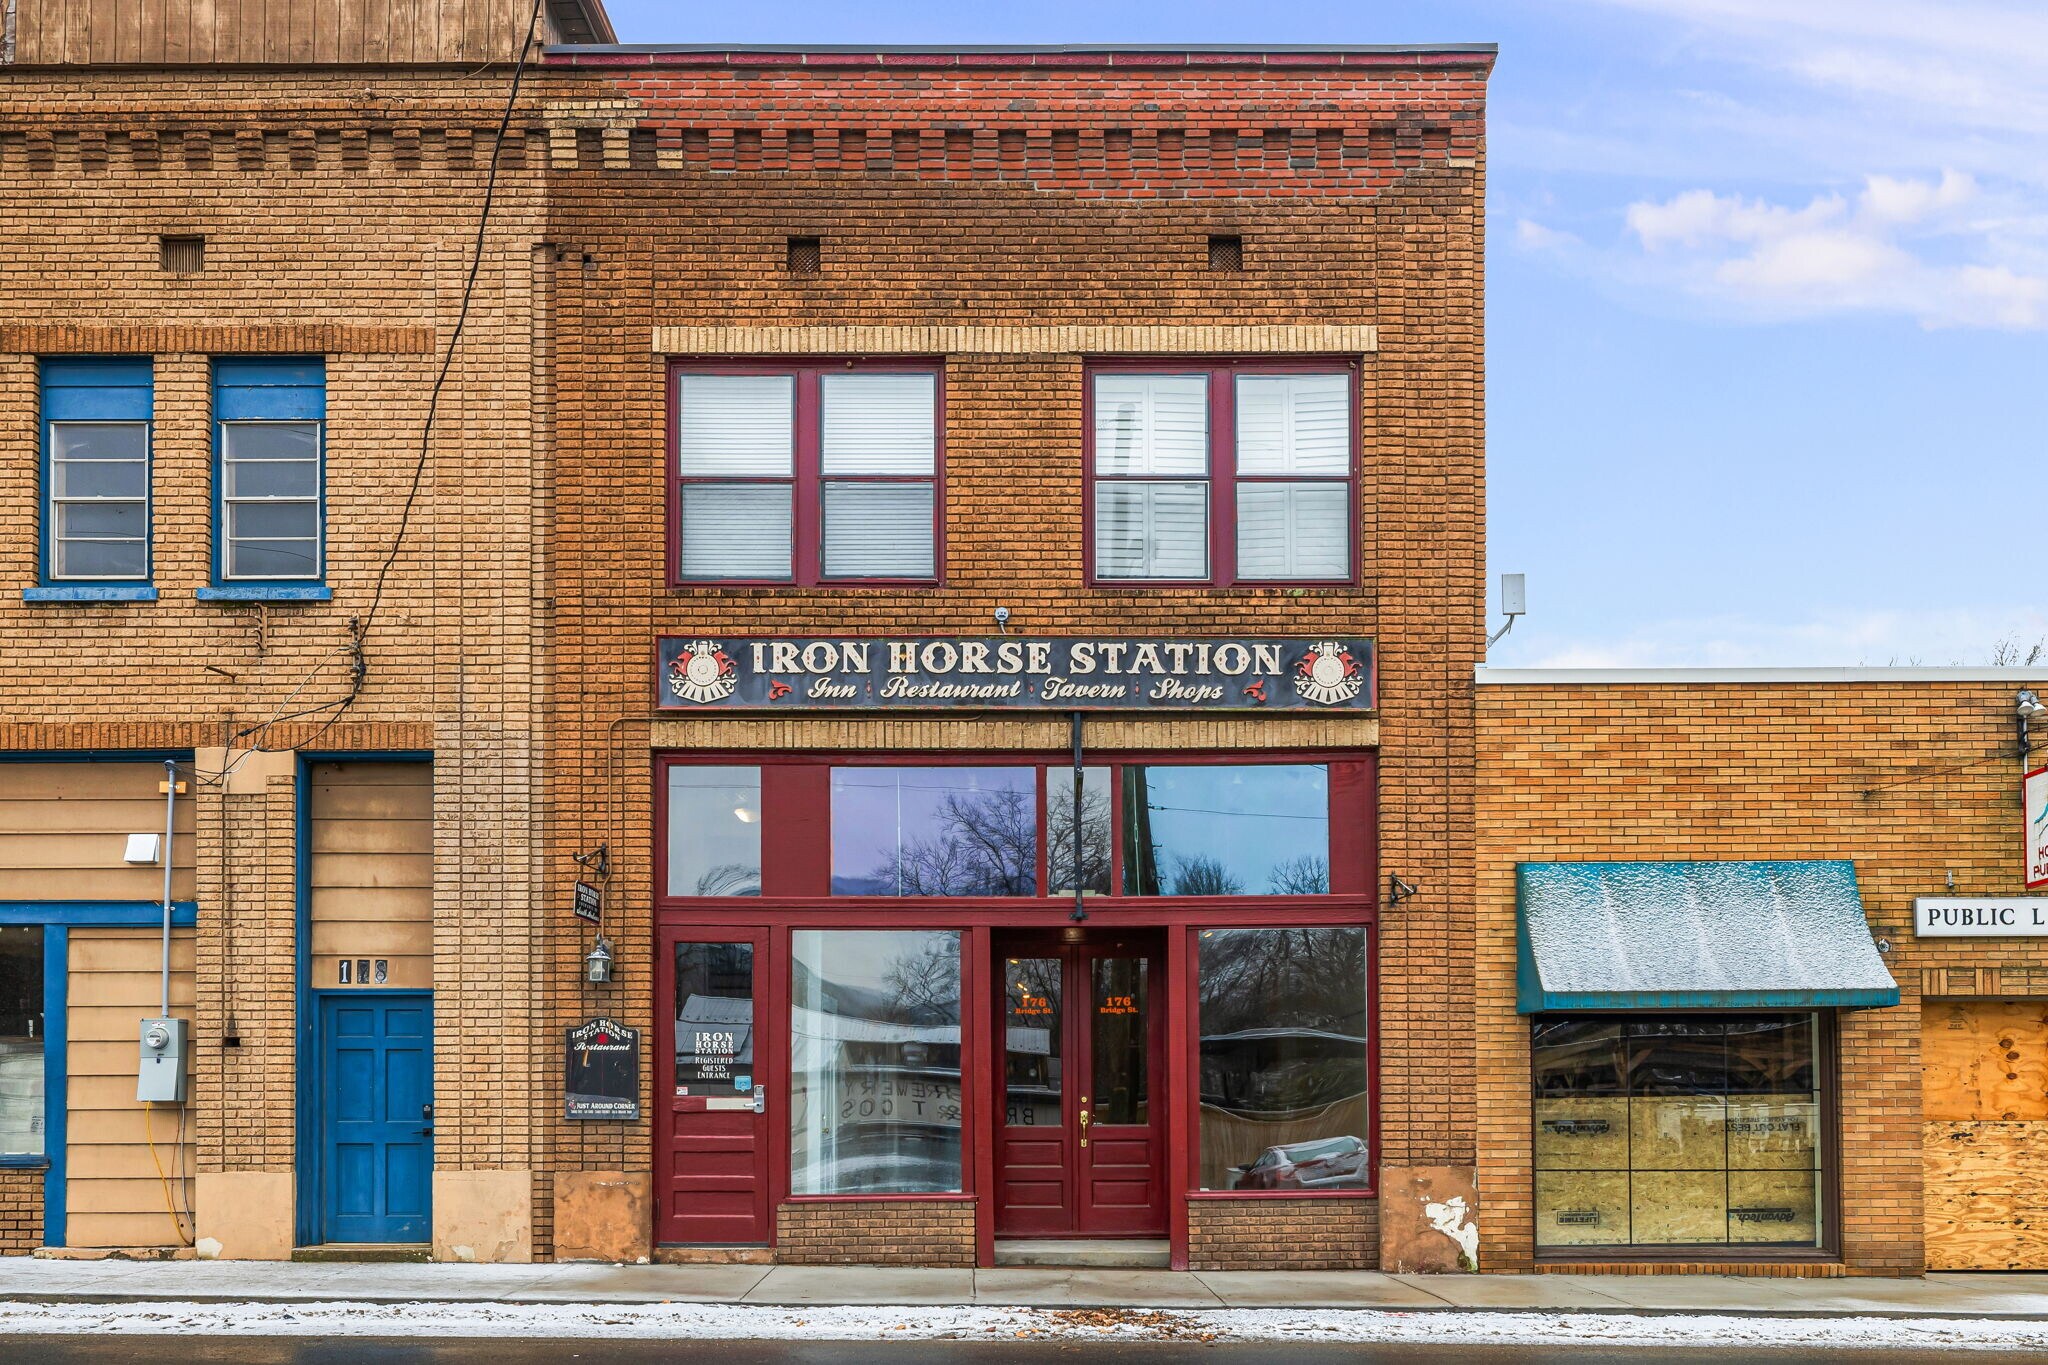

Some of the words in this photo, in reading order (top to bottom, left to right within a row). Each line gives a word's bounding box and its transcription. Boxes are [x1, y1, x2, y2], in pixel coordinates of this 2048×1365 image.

[750, 642, 871, 674] IRON
[887, 642, 1051, 675] HORSE
[1070, 642, 1284, 676] STATION
[807, 676, 857, 698] Inn
[880, 675, 1021, 699] Restaurant
[1040, 676, 1127, 700] Tavern
[1150, 677, 1223, 703] Shops
[1927, 908, 2015, 926] PUBLIC
[2032, 908, 2045, 925] L
[340, 960, 388, 983] 178
[1022, 997, 1047, 1007] 176
[1106, 996, 1131, 1007] 176
[1015, 1007, 1040, 1015] Bridge
[1100, 1007, 1124, 1015] Bridge
[1127, 1006, 1138, 1014] St.
[572, 1021, 597, 1039] IRON
[599, 1019, 633, 1040] HORSE
[583, 1026, 620, 1041] STATION
[695, 1032, 734, 1042] IRON
[695, 1041, 734, 1049] HORSE
[1776, 1123, 1800, 1132] FLAT
